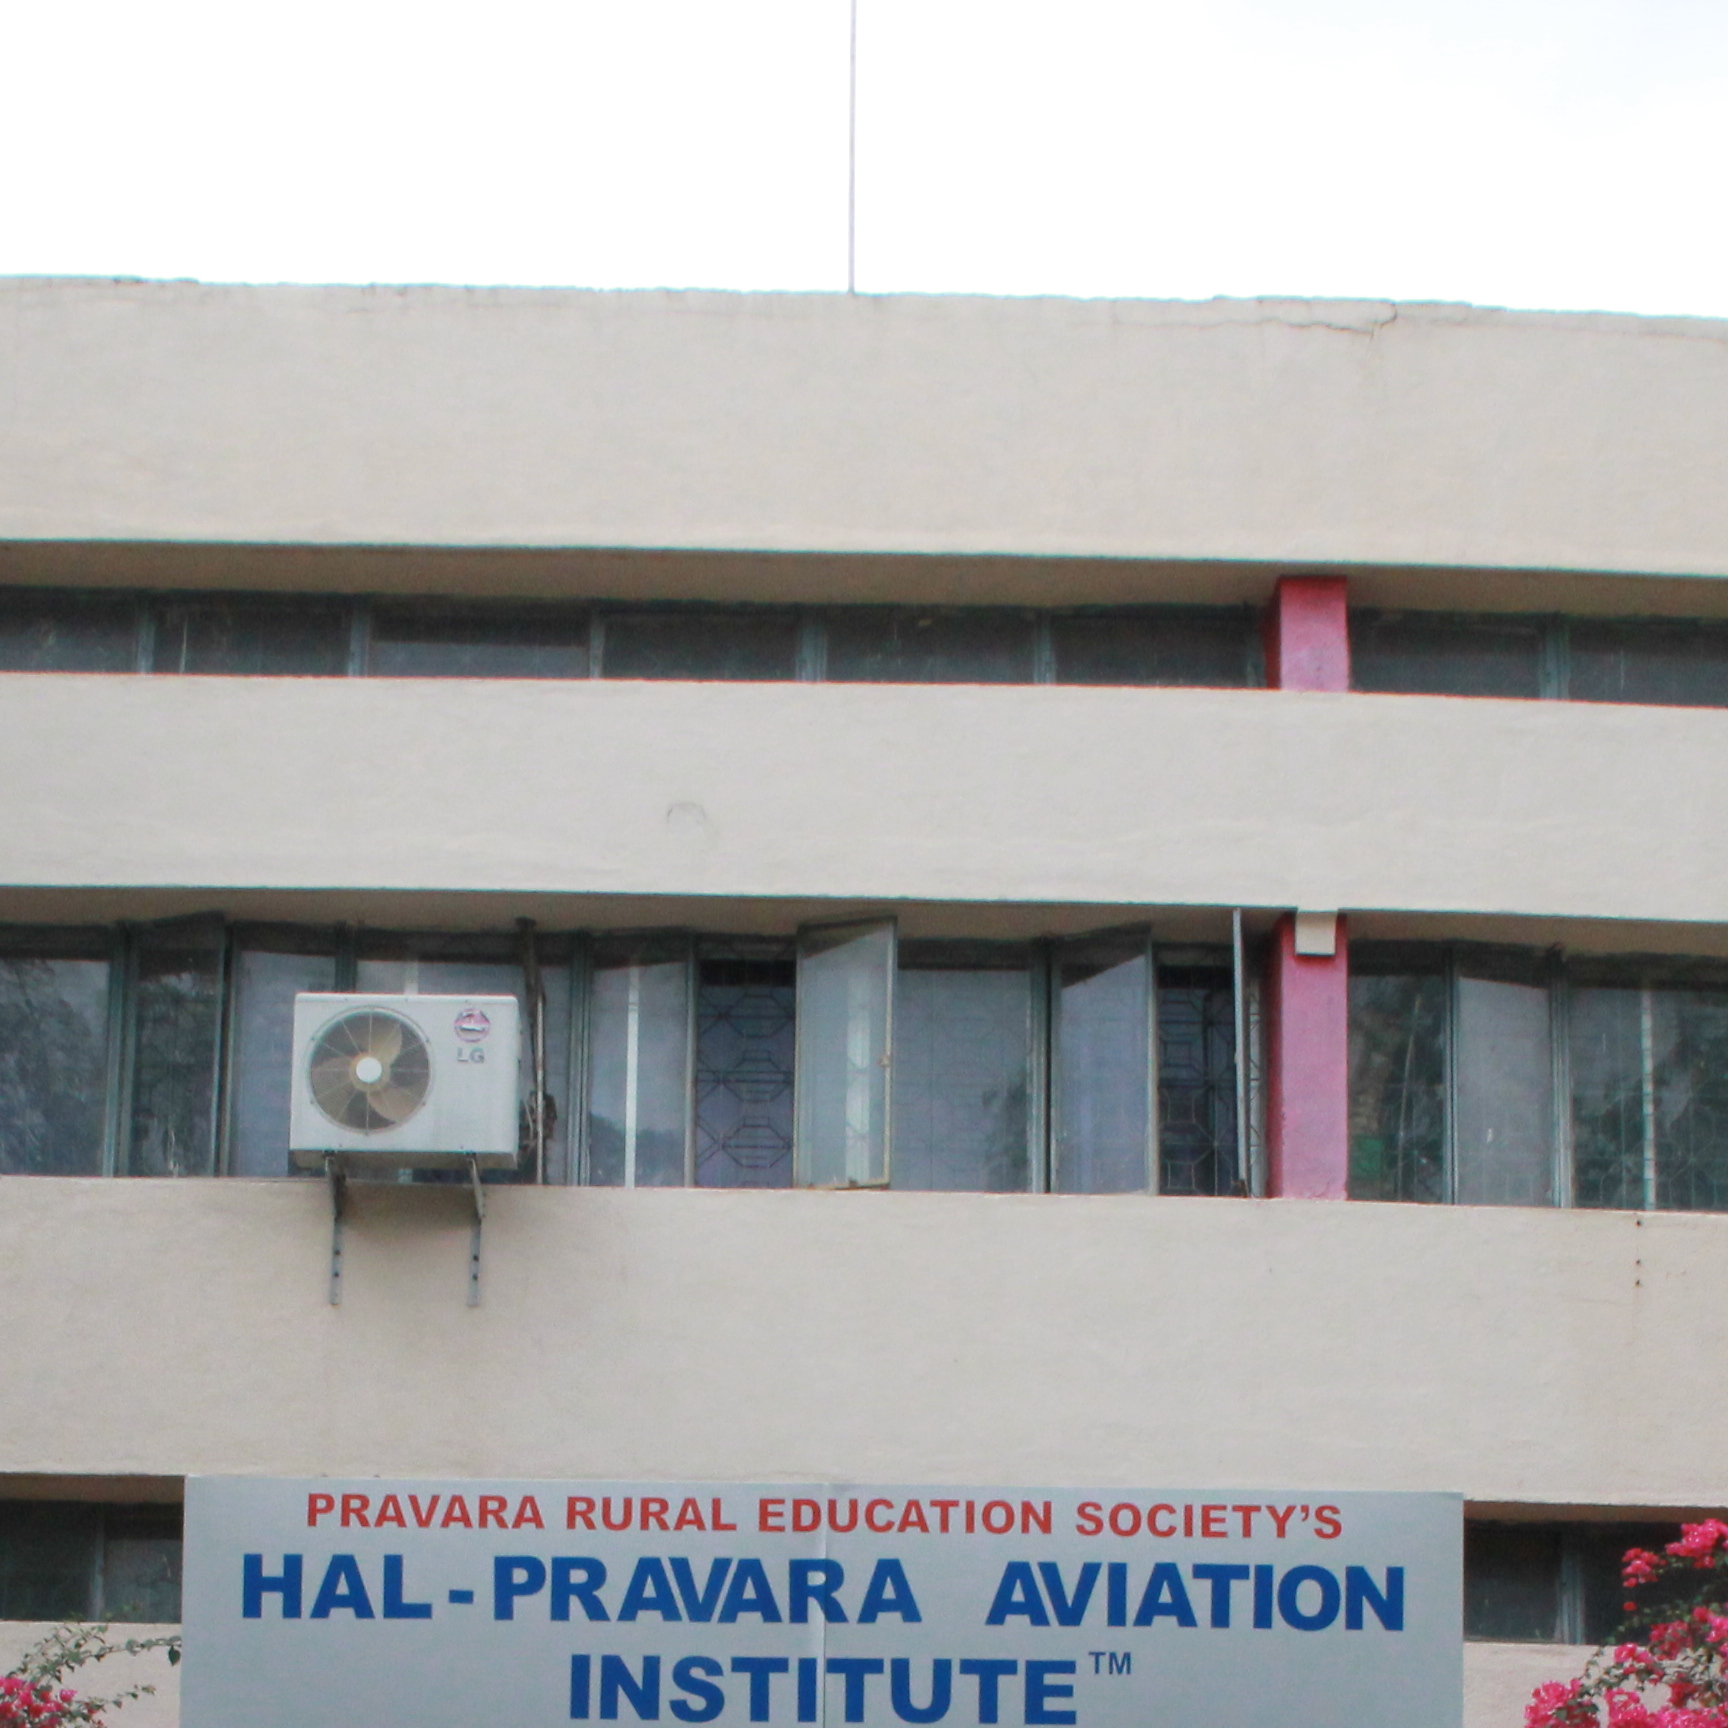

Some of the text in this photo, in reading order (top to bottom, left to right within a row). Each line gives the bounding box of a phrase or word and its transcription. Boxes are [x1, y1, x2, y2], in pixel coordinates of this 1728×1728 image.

[456, 1046, 486, 1064] LG
[307, 1492, 1344, 1541] PRAVARA RURAL EDUCATION SOCIETY'S
[984, 1559, 1408, 1633] AVIATION
[568, 1652, 1079, 1726] INSTITUTE
